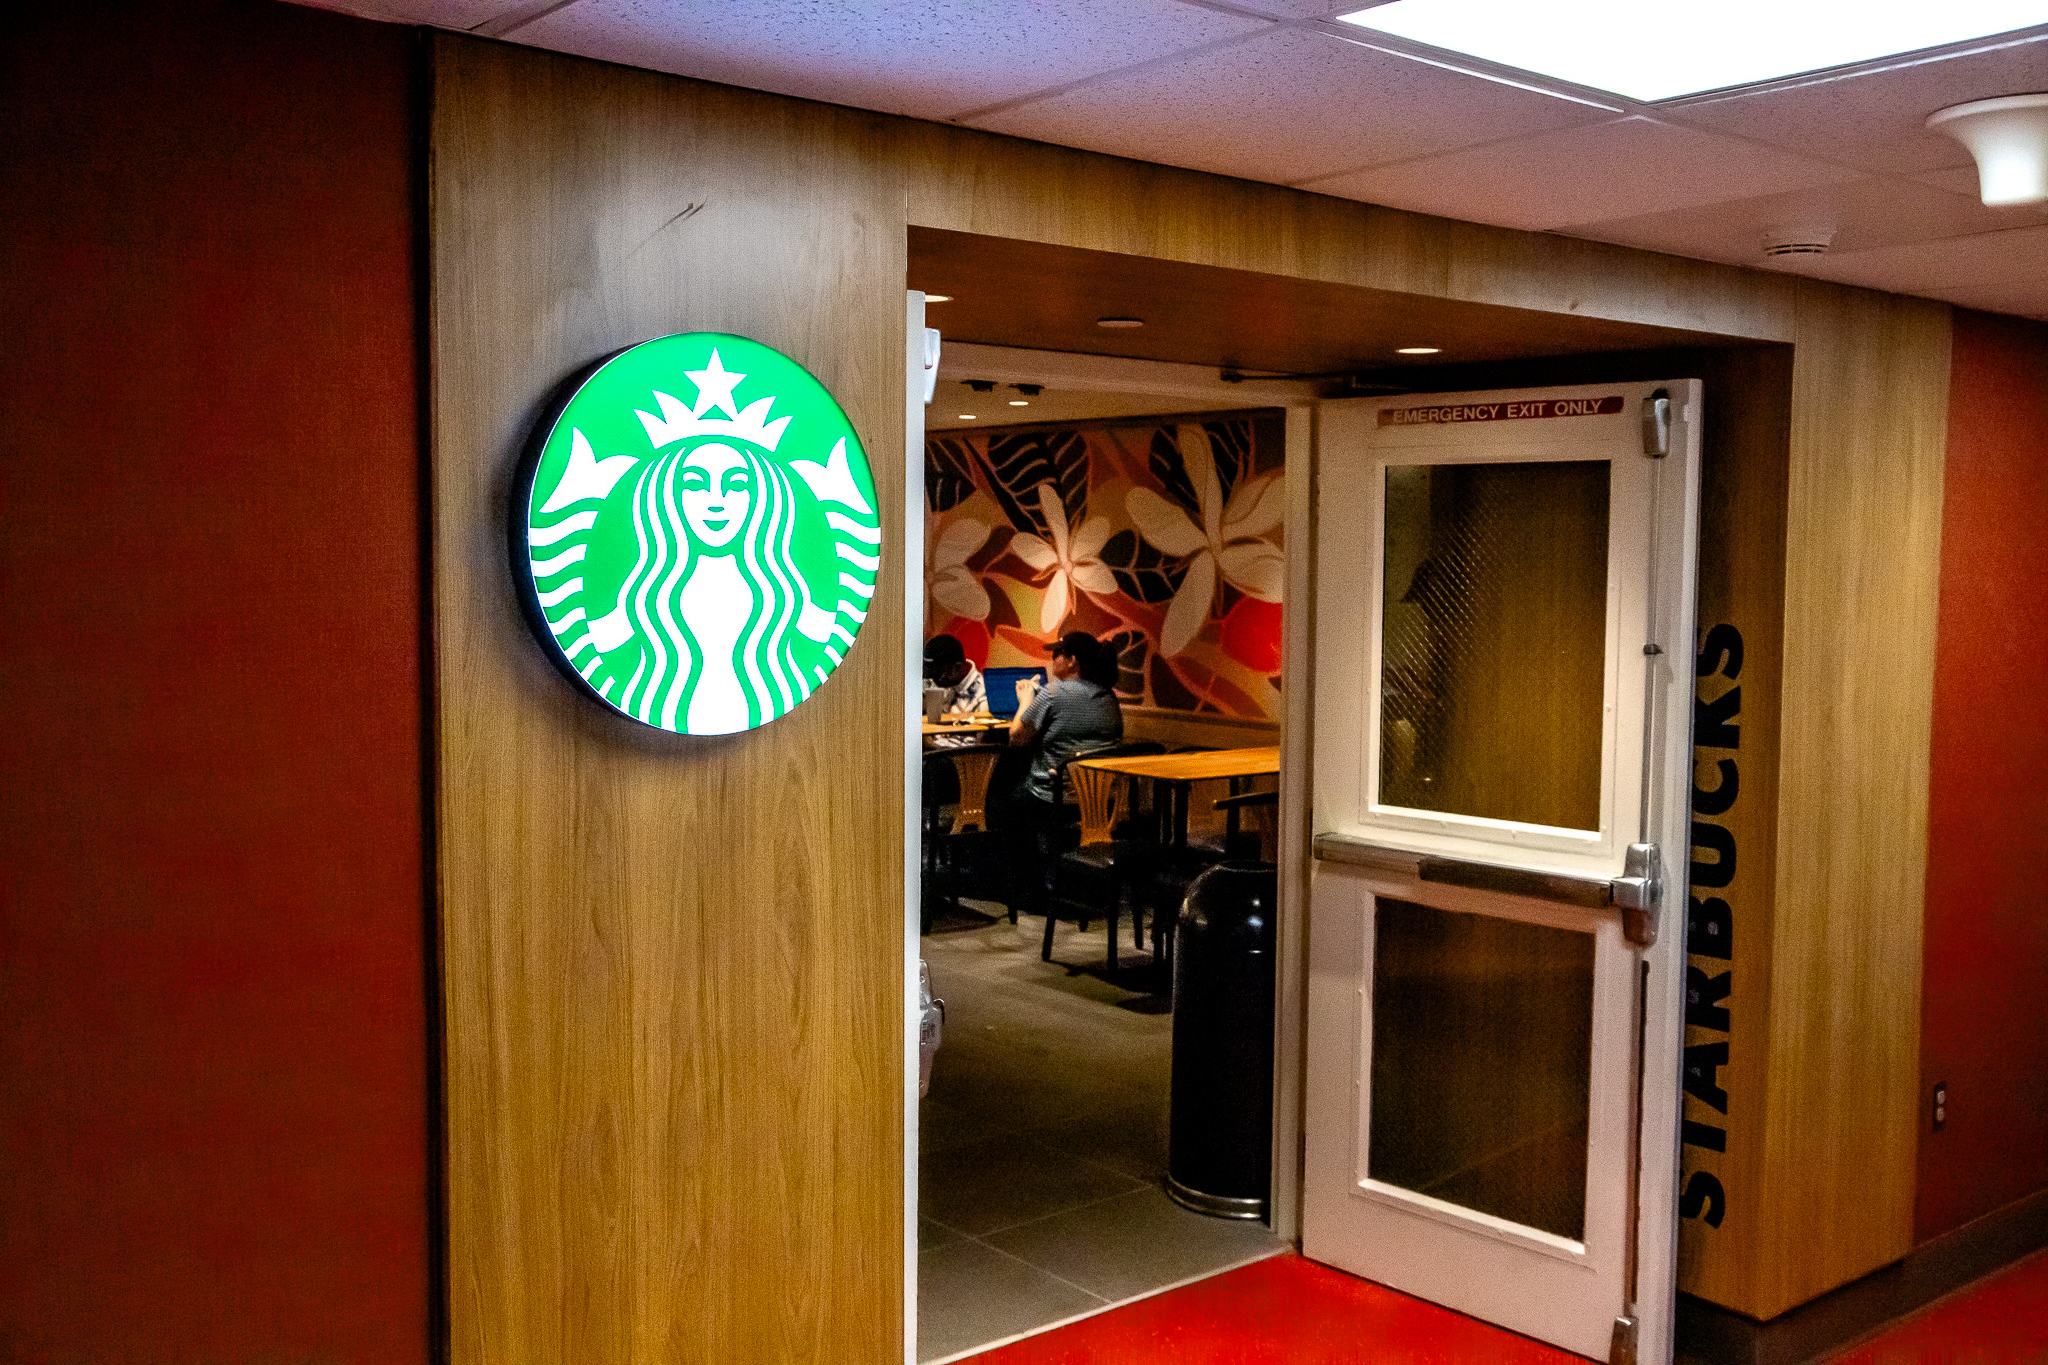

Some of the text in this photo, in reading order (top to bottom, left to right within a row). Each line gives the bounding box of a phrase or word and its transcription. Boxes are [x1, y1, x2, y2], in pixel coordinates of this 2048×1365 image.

[1393, 399, 1603, 424] EMERGENCY EXIT ONLY
[1680, 623, 1744, 1230] STARBUCKS
